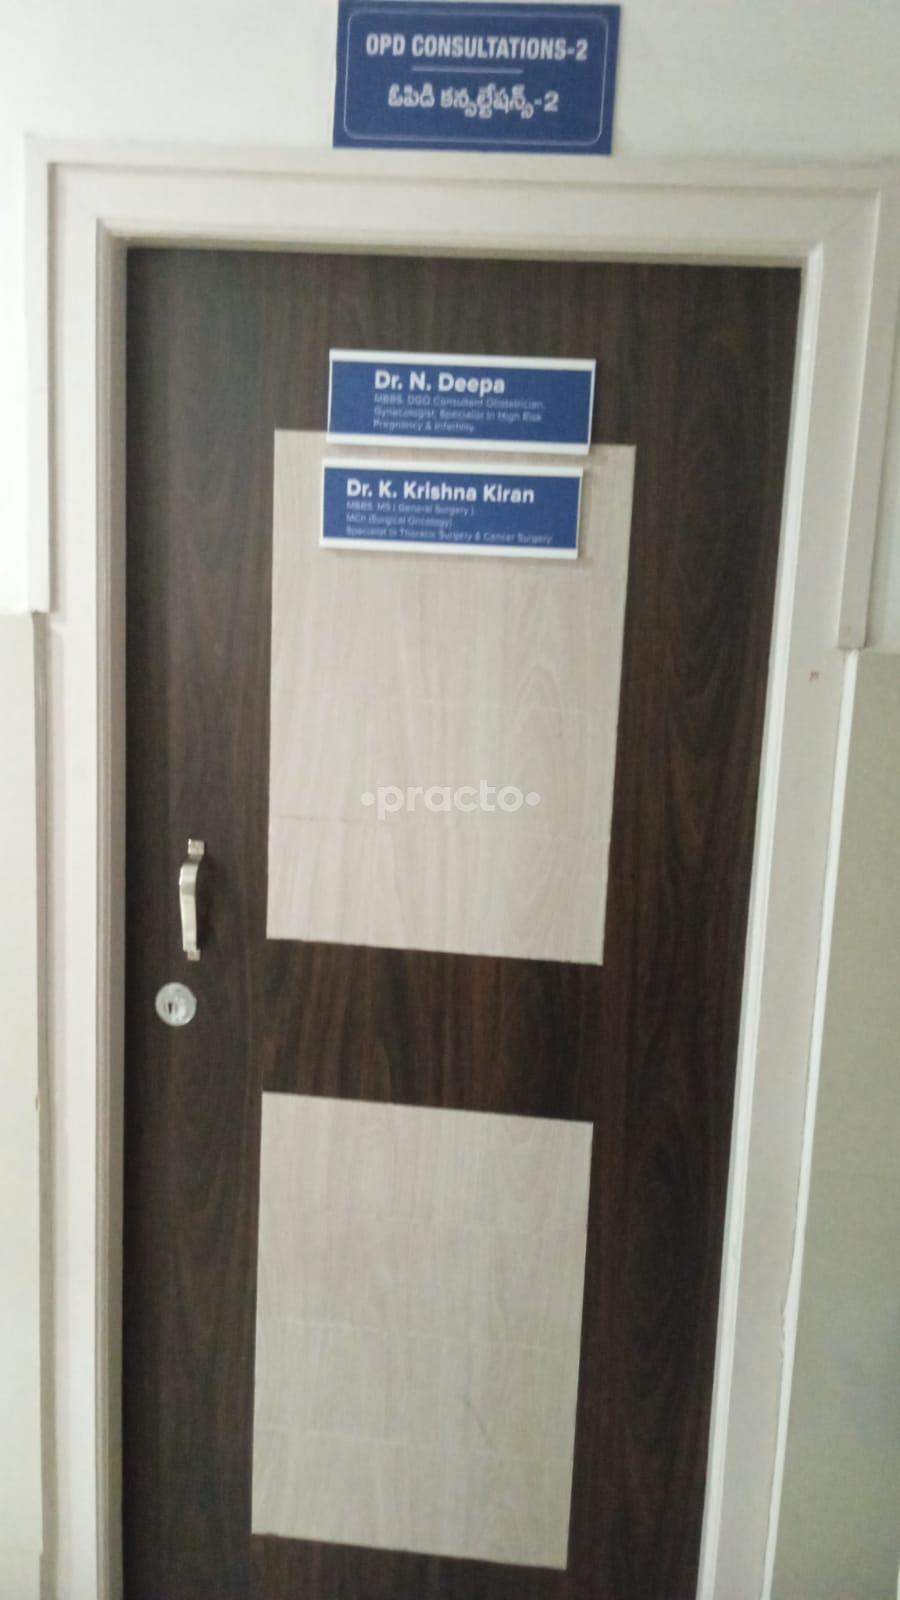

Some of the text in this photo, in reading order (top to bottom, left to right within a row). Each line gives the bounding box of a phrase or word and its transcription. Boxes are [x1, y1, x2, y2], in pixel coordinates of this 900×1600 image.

[366, 33, 589, 62] OPD CONSULTATIONS-2
[374, 369, 506, 397] Dr. N. Deepa
[424, 420, 433, 431] &
[521, 411, 543, 423] Risk
[346, 478, 535, 504] Dr. K. Krishna Kiran
